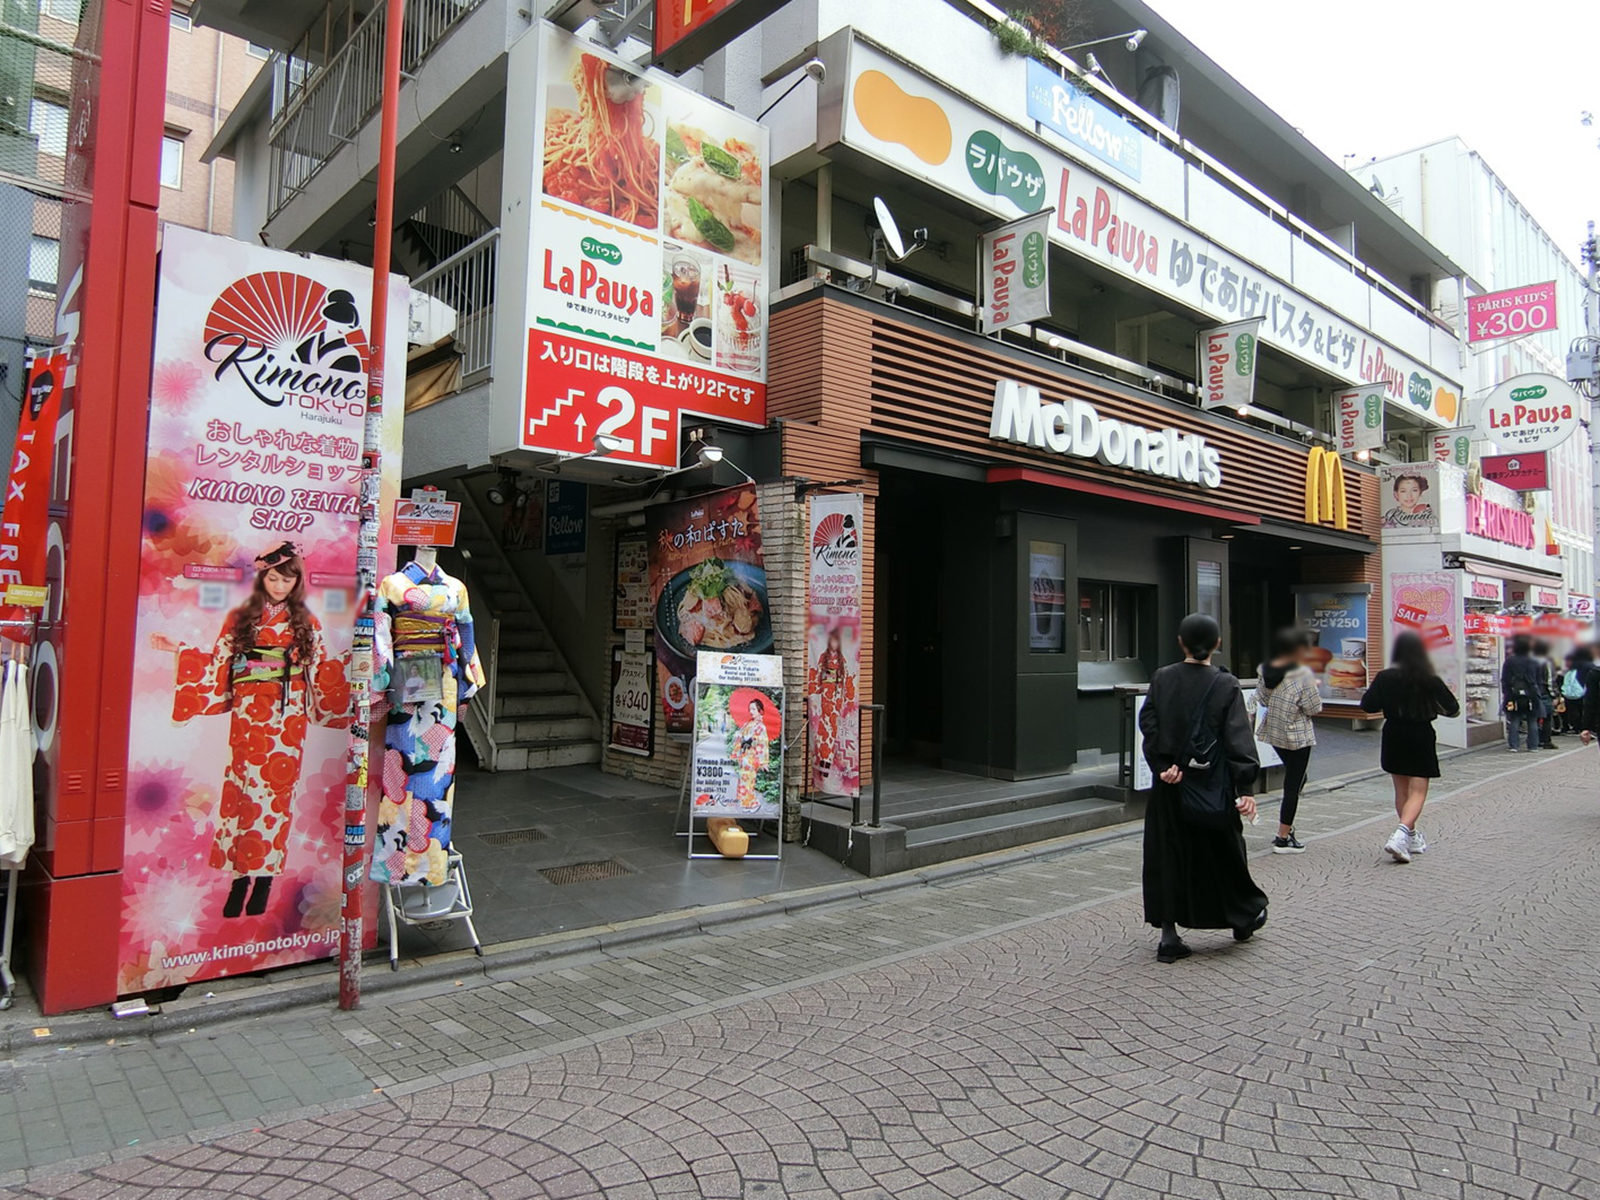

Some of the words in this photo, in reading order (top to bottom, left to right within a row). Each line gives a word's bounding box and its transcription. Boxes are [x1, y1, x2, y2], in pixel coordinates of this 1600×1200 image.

[1052, 85, 1123, 161] Fellow
[969, 142, 1044, 198] ラパウザ
[1477, 297, 1513, 313] PARIS
[1514, 291, 1548, 306] KID'S
[1476, 305, 1548, 338] ¥300
[204, 331, 367, 408] Kimono
[540, 340, 755, 406] 入り口は階段を上がり2Fです
[284, 391, 365, 417] TOKYO
[301, 411, 343, 426] Harajuku
[596, 385, 670, 456] 2F
[206, 419, 360, 461] おしゃれな着物
[989, 379, 1222, 490] McDonald's
[8, 430, 37, 502] TAX
[189, 478, 285, 506] KIMONO
[250, 508, 314, 532] SHOP
[549, 515, 583, 536] Fellow
[658, 517, 745, 552] 秋の和ぱすた
[813, 544, 859, 567] Kimono
[1397, 608, 1425, 622] SALE
[161, 927, 342, 970] www.kimonotokyo.jp
